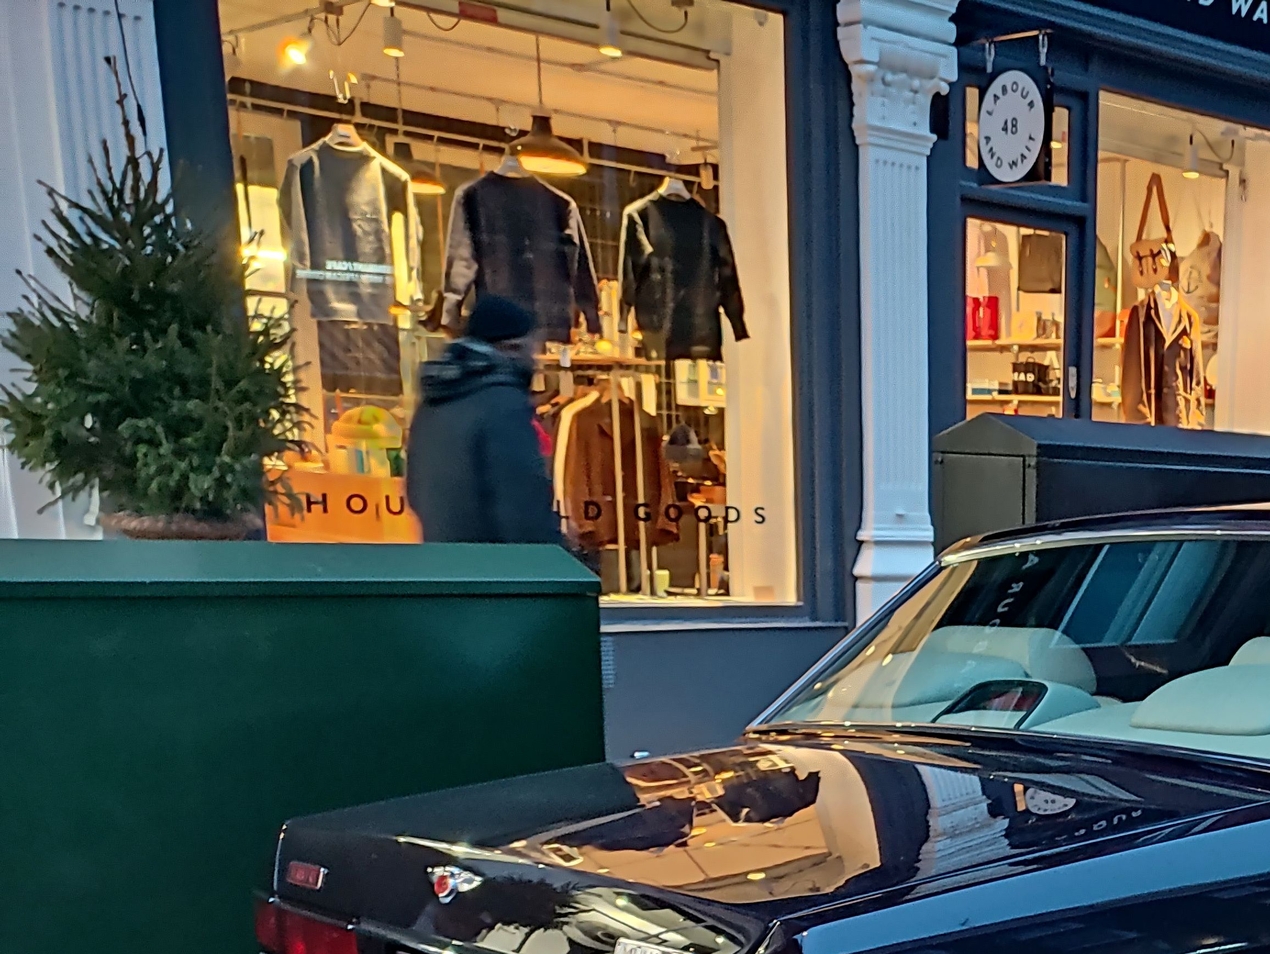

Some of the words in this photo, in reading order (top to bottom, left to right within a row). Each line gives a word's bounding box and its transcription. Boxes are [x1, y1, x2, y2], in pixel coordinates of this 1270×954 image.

[986, 81, 1035, 116] LABOUR
[1001, 117, 1018, 135] 48
[984, 135, 1003, 169] AND
[1008, 133, 1036, 170] WAIT
[634, 502, 766, 525] GOODS
